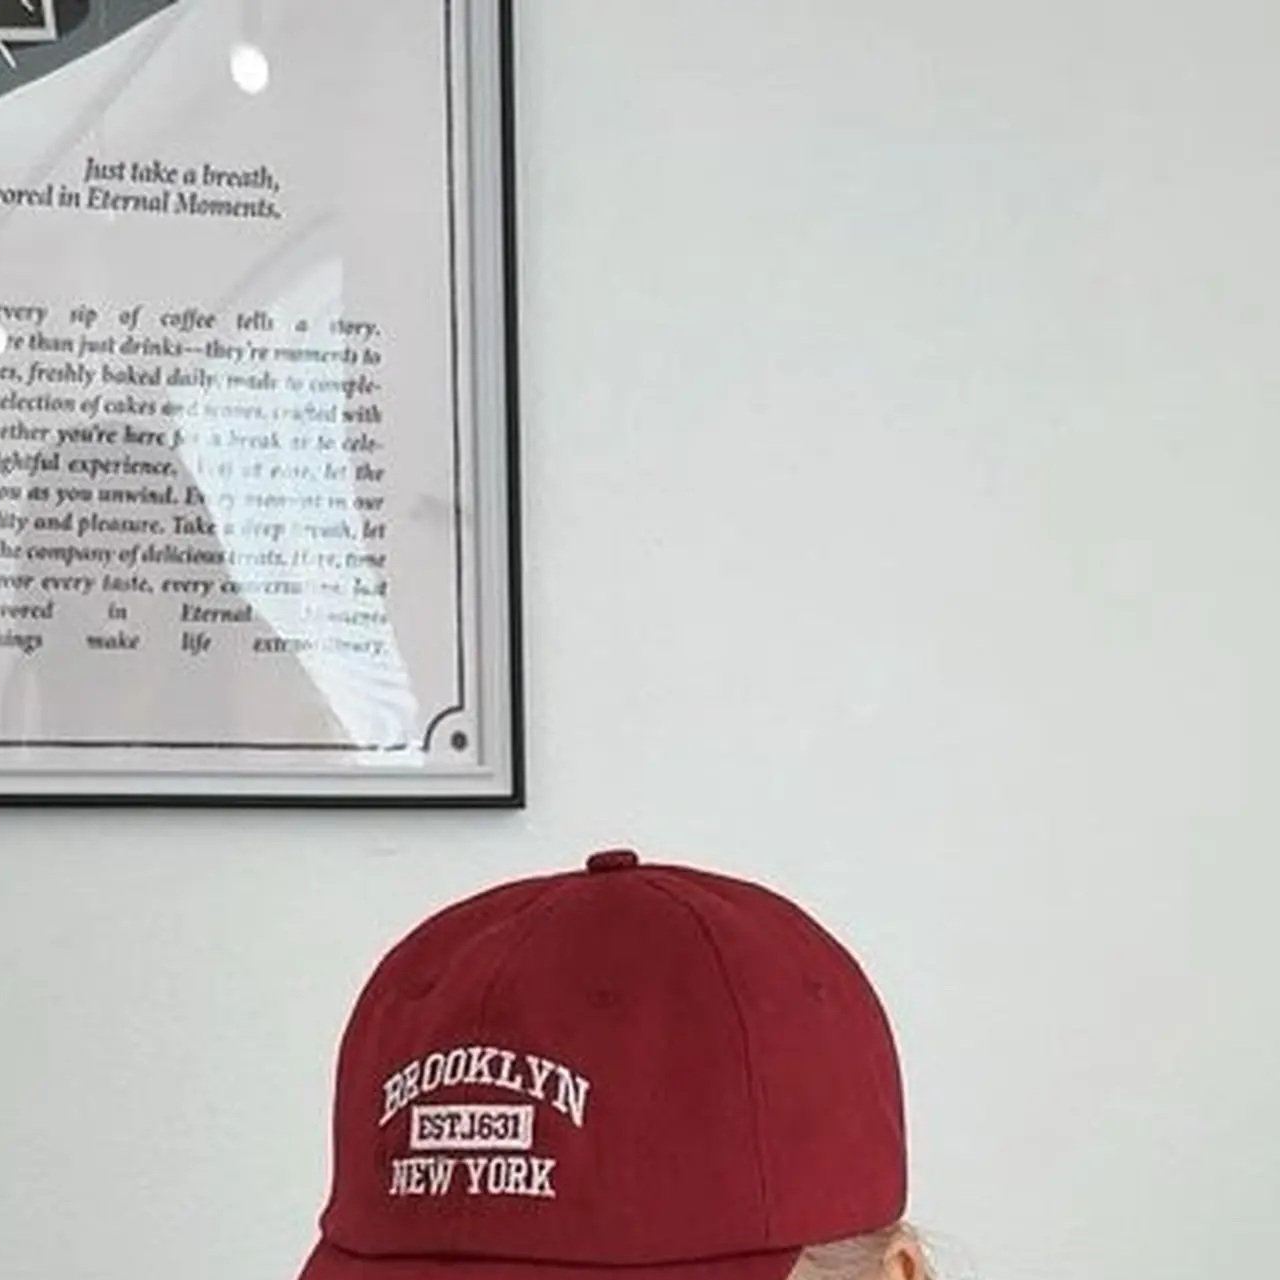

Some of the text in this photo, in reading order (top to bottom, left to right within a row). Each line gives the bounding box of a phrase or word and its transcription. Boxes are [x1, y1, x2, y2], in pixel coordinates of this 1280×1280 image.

[84, 157, 280, 193] Just take a breath,
[58, 186, 80, 208] in
[86, 187, 169, 213] Eternal
[175, 191, 282, 219] Moments.
[70, 305, 97, 329] sip
[119, 305, 145, 331] of
[160, 307, 216, 334] coffee
[237, 311, 274, 331] tells
[28, 330, 73, 352] than
[76, 334, 116, 359] just
[26, 360, 97, 388] freshly
[103, 363, 161, 385] baked
[81, 392, 102, 418] of
[104, 393, 155, 414] cakes
[342, 402, 381, 423] with
[58, 421, 116, 448] you're
[124, 424, 164, 444] here
[68, 453, 177, 480] experience.
[356, 462, 384, 481] the
[28, 486, 47, 500] as
[56, 487, 91, 507] you
[99, 483, 177, 504] unwind.
[355, 496, 384, 511] our
[34, 510, 72, 530] and
[77, 511, 164, 538] pleasure.
[173, 514, 217, 535] Take
[364, 520, 385, 539] let
[27, 546, 113, 567] company
[118, 542, 140, 568] of
[141, 543, 224, 564] delicious
[41, 576, 94, 596] every
[102, 573, 153, 594] taste,
[162, 578, 214, 599] every
[108, 603, 127, 621] in
[181, 603, 252, 624] Eternal
[87, 630, 140, 650] make
[182, 632, 212, 657] life
[378, 1046, 590, 1128] BROOKLYN
[419, 1111, 522, 1141] EST.1631
[388, 1156, 557, 1197] NEW YORK
